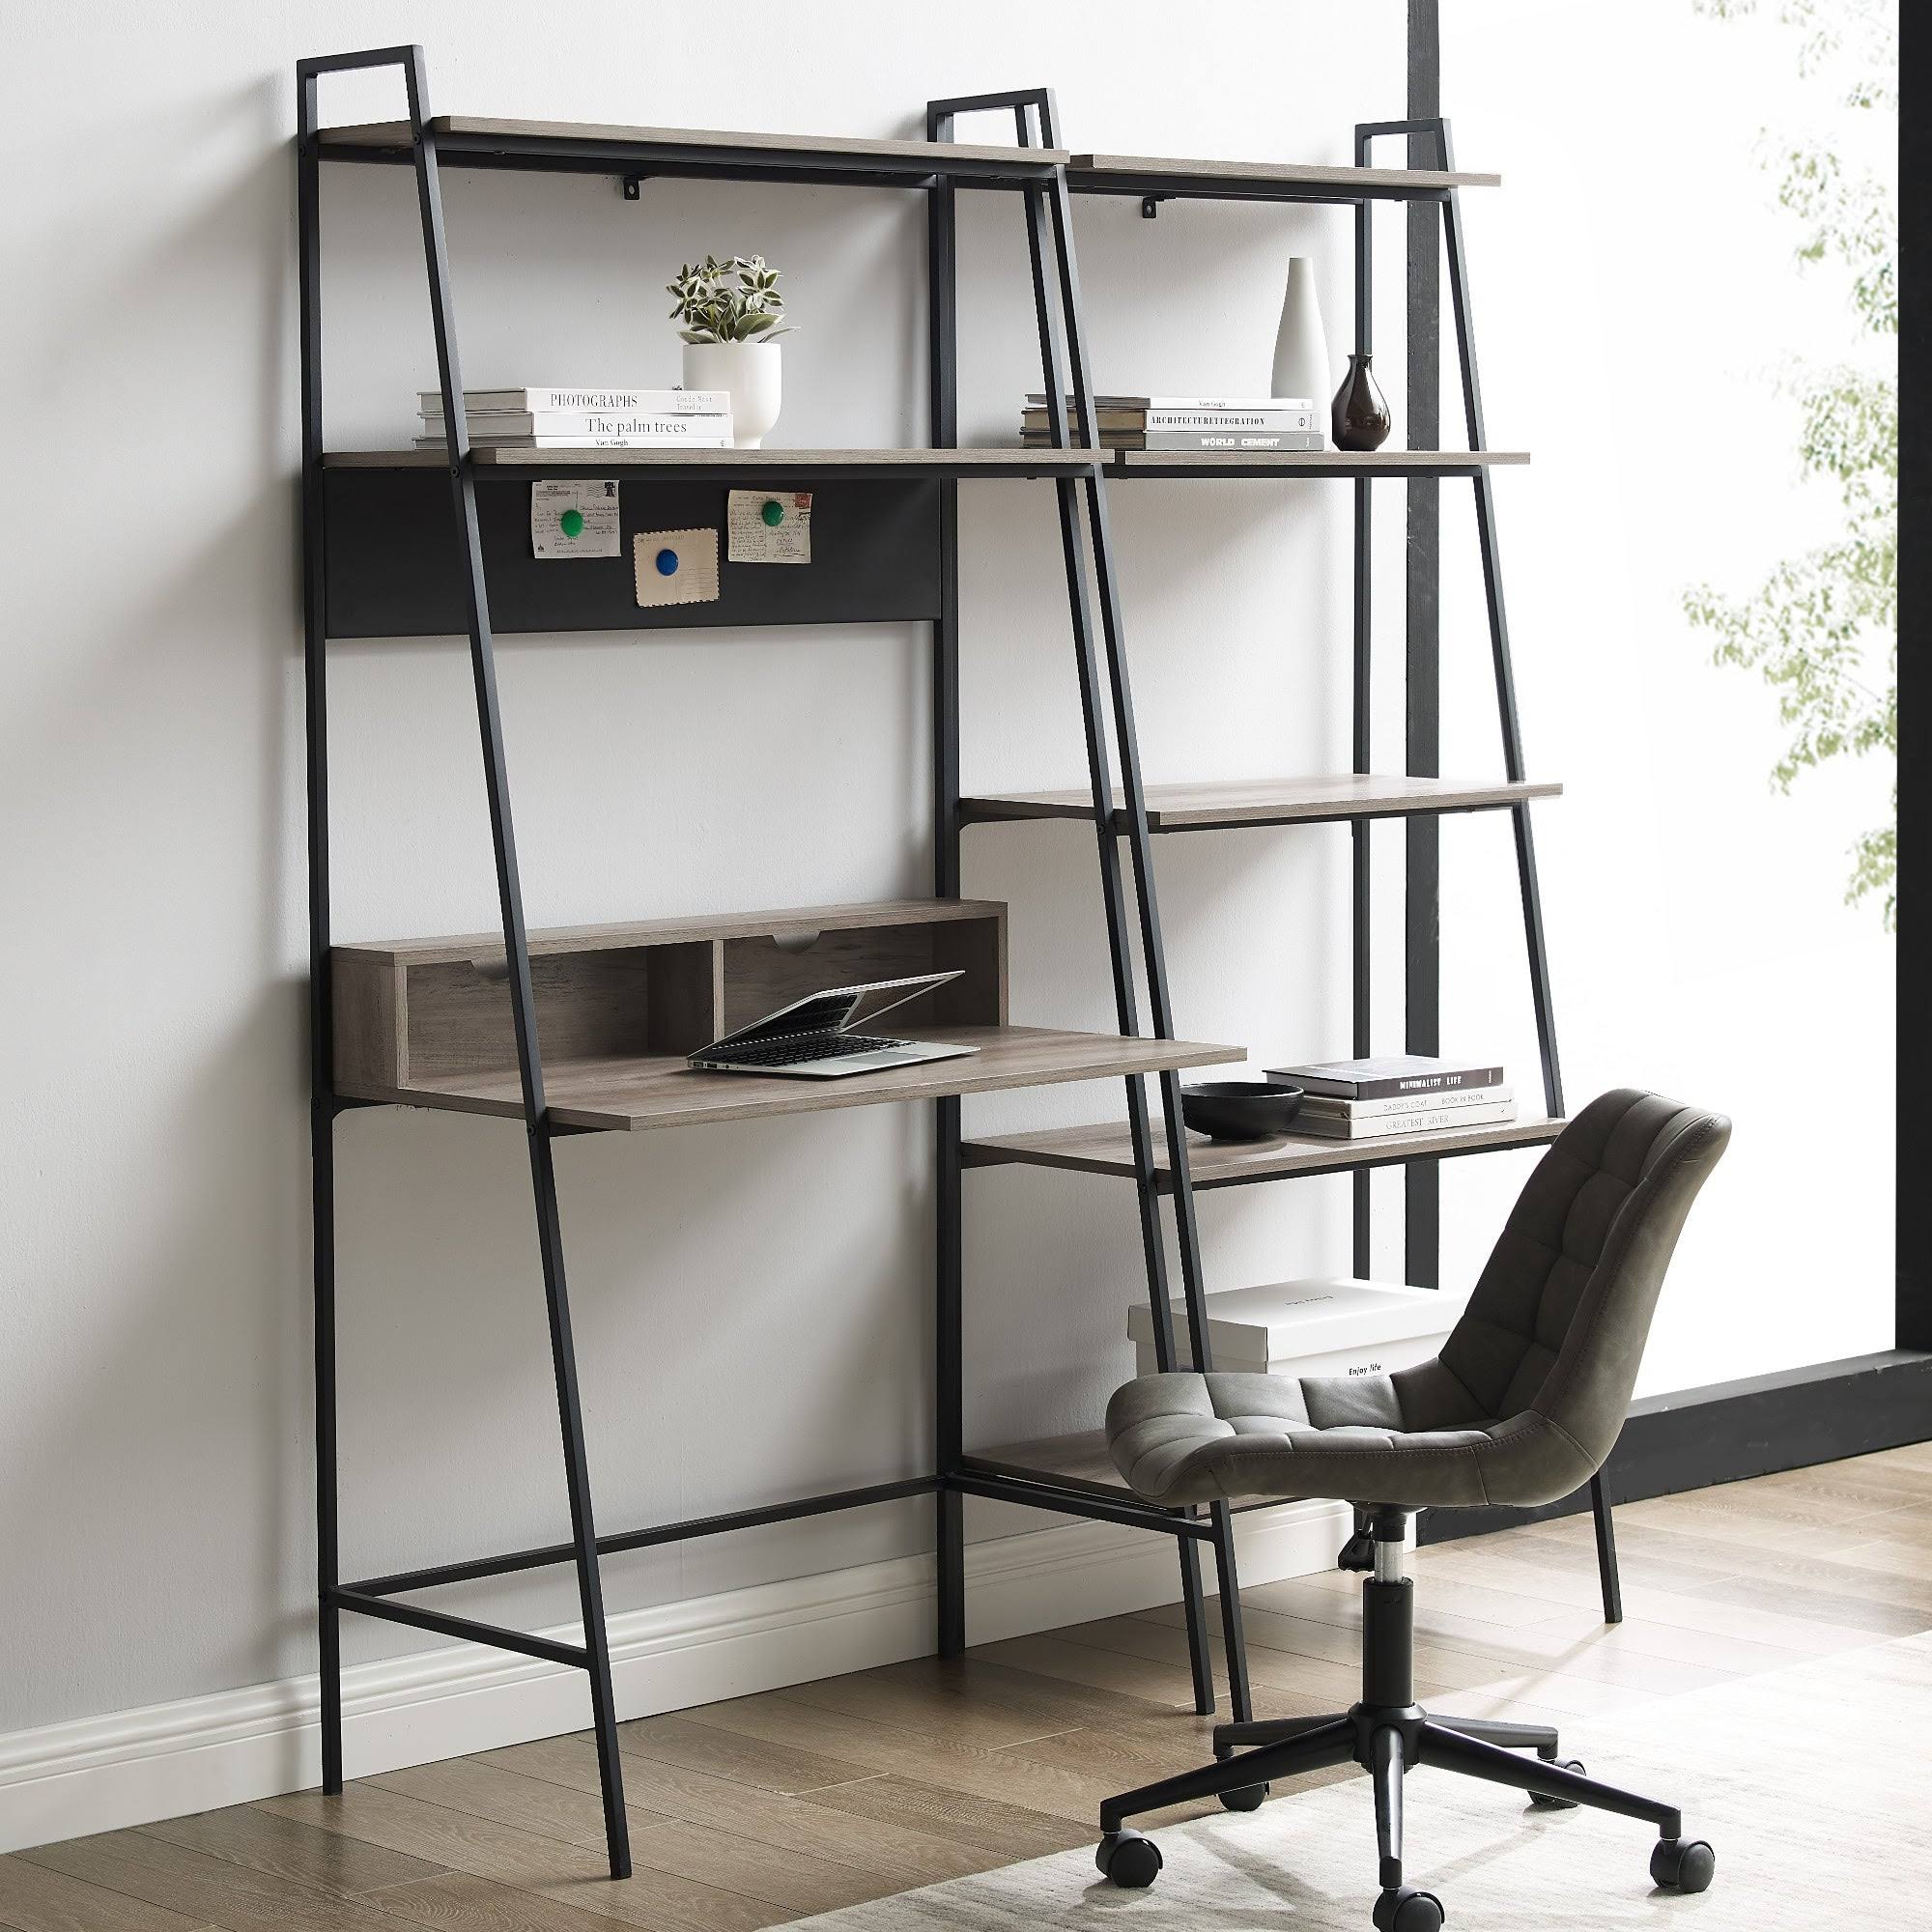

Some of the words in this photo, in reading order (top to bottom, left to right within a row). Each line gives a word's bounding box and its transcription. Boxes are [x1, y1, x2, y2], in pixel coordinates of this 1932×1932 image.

[551, 393, 638, 408] PHOTOGRAPHS
[585, 418, 613, 433] The
[617, 419, 650, 436] palm
[655, 422, 687, 433] trees
[1201, 437, 1236, 446] WORLD
[1241, 438, 1280, 446] CEMENT
[1400, 1078, 1441, 1090] MINIMALIST
[1446, 1076, 1462, 1086] LIFE
[1385, 1118, 1423, 1130] GREATEST
[1349, 1367, 1368, 1377] Enjoy
[1370, 1363, 1381, 1372] life
